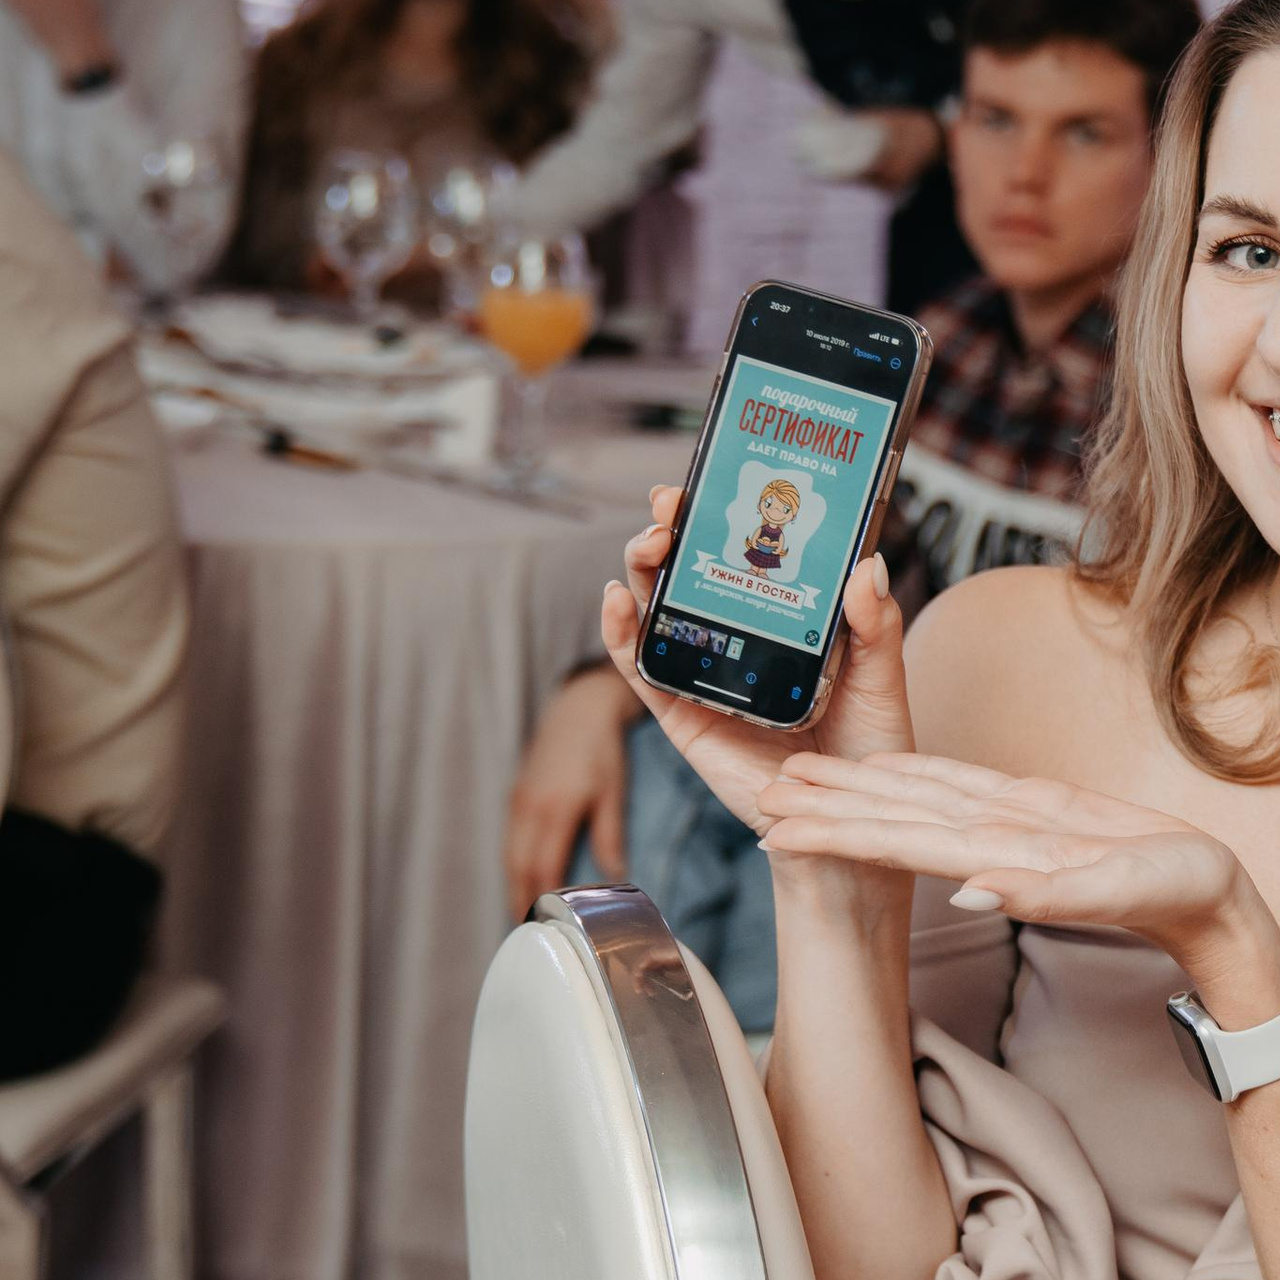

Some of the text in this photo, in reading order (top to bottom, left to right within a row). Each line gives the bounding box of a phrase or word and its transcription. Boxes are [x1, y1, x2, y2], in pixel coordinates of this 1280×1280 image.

[770, 301, 791, 314] 20:37
[806, 329, 814, 338] 10
[880, 334, 890, 343] LTE
[761, 385, 859, 424] подарочный
[739, 398, 865, 465] СЕРТИФИКАТ
[747, 440, 837, 477] ДАЕТ ПРАВО НА
[710, 567, 744, 586] УЖИН
[746, 579, 754, 589] В
[756, 582, 800, 605] ГОСТЯХ
